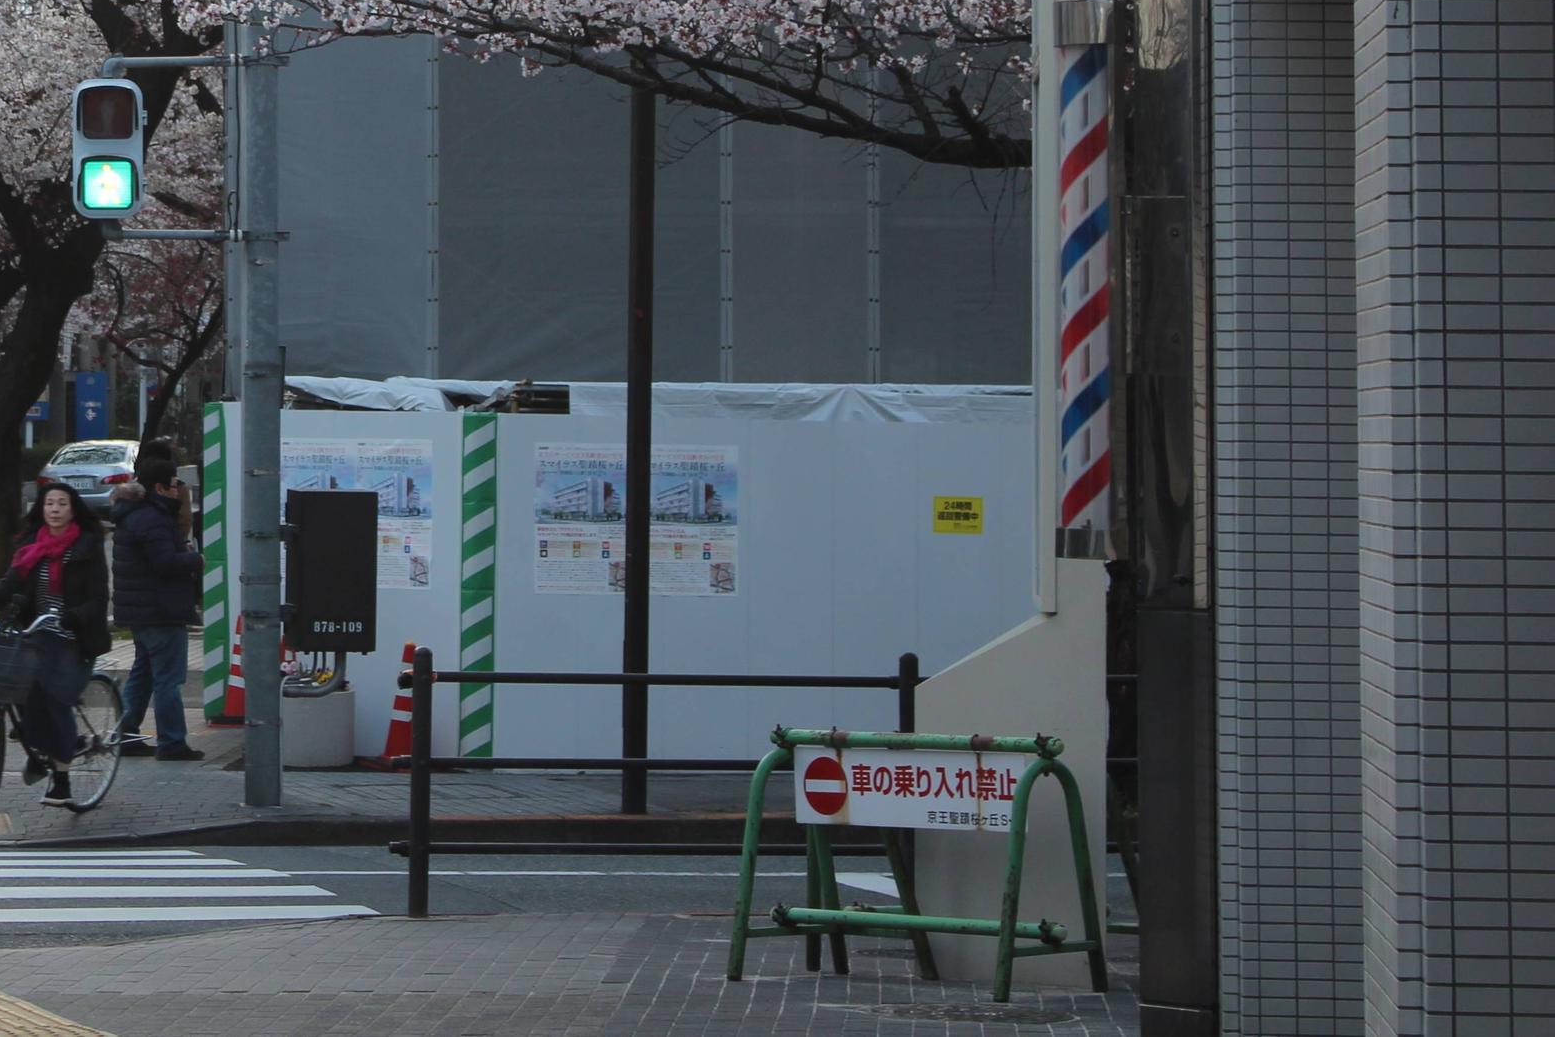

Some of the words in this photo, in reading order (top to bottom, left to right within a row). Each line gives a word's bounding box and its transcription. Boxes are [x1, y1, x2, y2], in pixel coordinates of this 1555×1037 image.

[651, 461, 726, 472] マイラス聖蹟桜ヶ丘
[313, 621, 363, 633] 878-109
[851, 764, 1017, 801] 車の乗り入れ禁止
